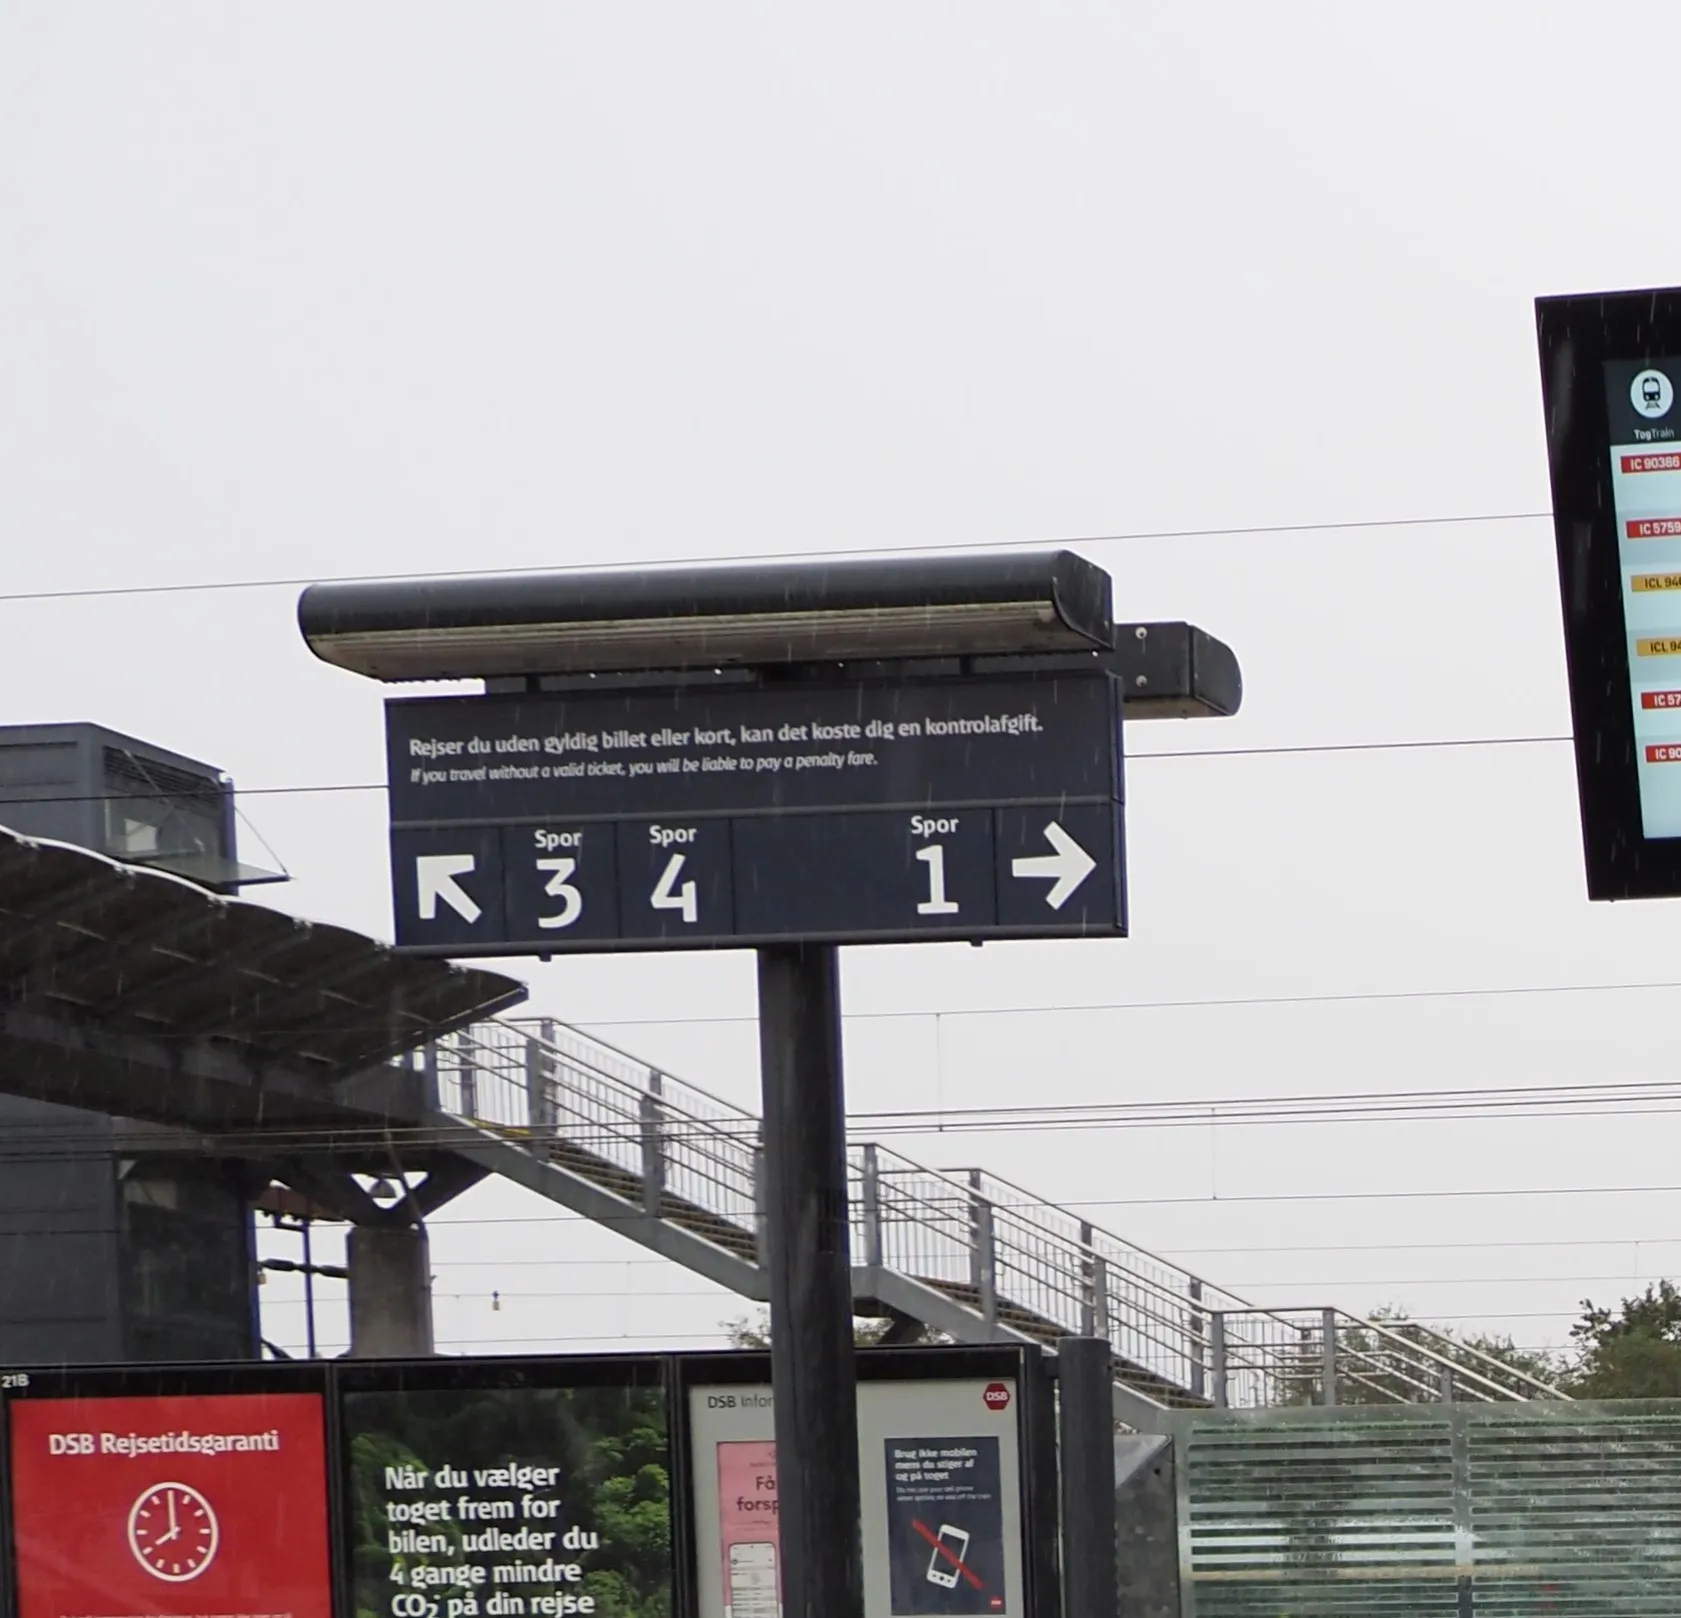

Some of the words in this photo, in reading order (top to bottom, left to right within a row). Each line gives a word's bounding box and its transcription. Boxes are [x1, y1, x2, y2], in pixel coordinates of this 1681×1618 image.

[1631, 458, 1643, 470] IC
[1640, 524, 1650, 534] IC
[1645, 578, 1661, 588] ICL
[1650, 642, 1666, 653] ICL
[1654, 695, 1666, 706] IC
[410, 737, 463, 759] Rejser
[468, 736, 491, 754] du
[496, 735, 540, 752] uden
[545, 732, 598, 754] gyldig
[602, 730, 646, 749] billet
[651, 728, 690, 746] eller
[694, 727, 736, 746] kort,
[741, 725, 773, 742] kan
[778, 723, 808, 741] det
[812, 721, 860, 740] koste
[865, 719, 895, 740] dig
[898, 721, 921, 736] en
[925, 714, 1043, 737] kontrolafgift.
[1656, 748, 1666, 760] IC
[411, 770, 420, 783] If
[422, 770, 446, 785] you
[450, 766, 486, 781] travel
[489, 764, 537, 779] without
[541, 767, 550, 778] a
[553, 761, 584, 777] valid
[588, 760, 625, 776] ticket,
[629, 761, 653, 778] you
[656, 758, 680, 773] will
[682, 757, 699, 772] be
[702, 756, 737, 771] liable
[740, 756, 754, 770] to
[756, 756, 782, 771] pay
[784, 756, 793, 767] a
[796, 753, 845, 769] penalty
[848, 751, 878, 765] fare.
[535, 829, 582, 851] Spor
[649, 825, 697, 847] Spor
[911, 815, 959, 837] Spor
[536, 857, 583, 928] 3
[650, 853, 698, 922] 4
[916, 845, 959, 914] 1
[708, 1396, 736, 1409] DSB
[986, 1392, 1008, 1401] DSB
[50, 1434, 94, 1454] DSB
[100, 1430, 279, 1457] Rejsetidsgaranti
[385, 1465, 428, 1489] Når
[434, 1464, 468, 1488] du
[474, 1462, 560, 1490] vælger
[756, 1475, 776, 1490] Få
[387, 1501, 451, 1525] toget
[458, 1496, 514, 1520] frem
[522, 1494, 560, 1518] for
[389, 1530, 454, 1556] bilen,
[462, 1527, 556, 1551] udleder
[562, 1526, 598, 1550] du
[390, 1564, 404, 1584] 4
[411, 1565, 486, 1589] gange
[493, 1559, 582, 1584] mindre
[486, 1591, 524, 1615] din
[531, 1591, 595, 1618] rejse
